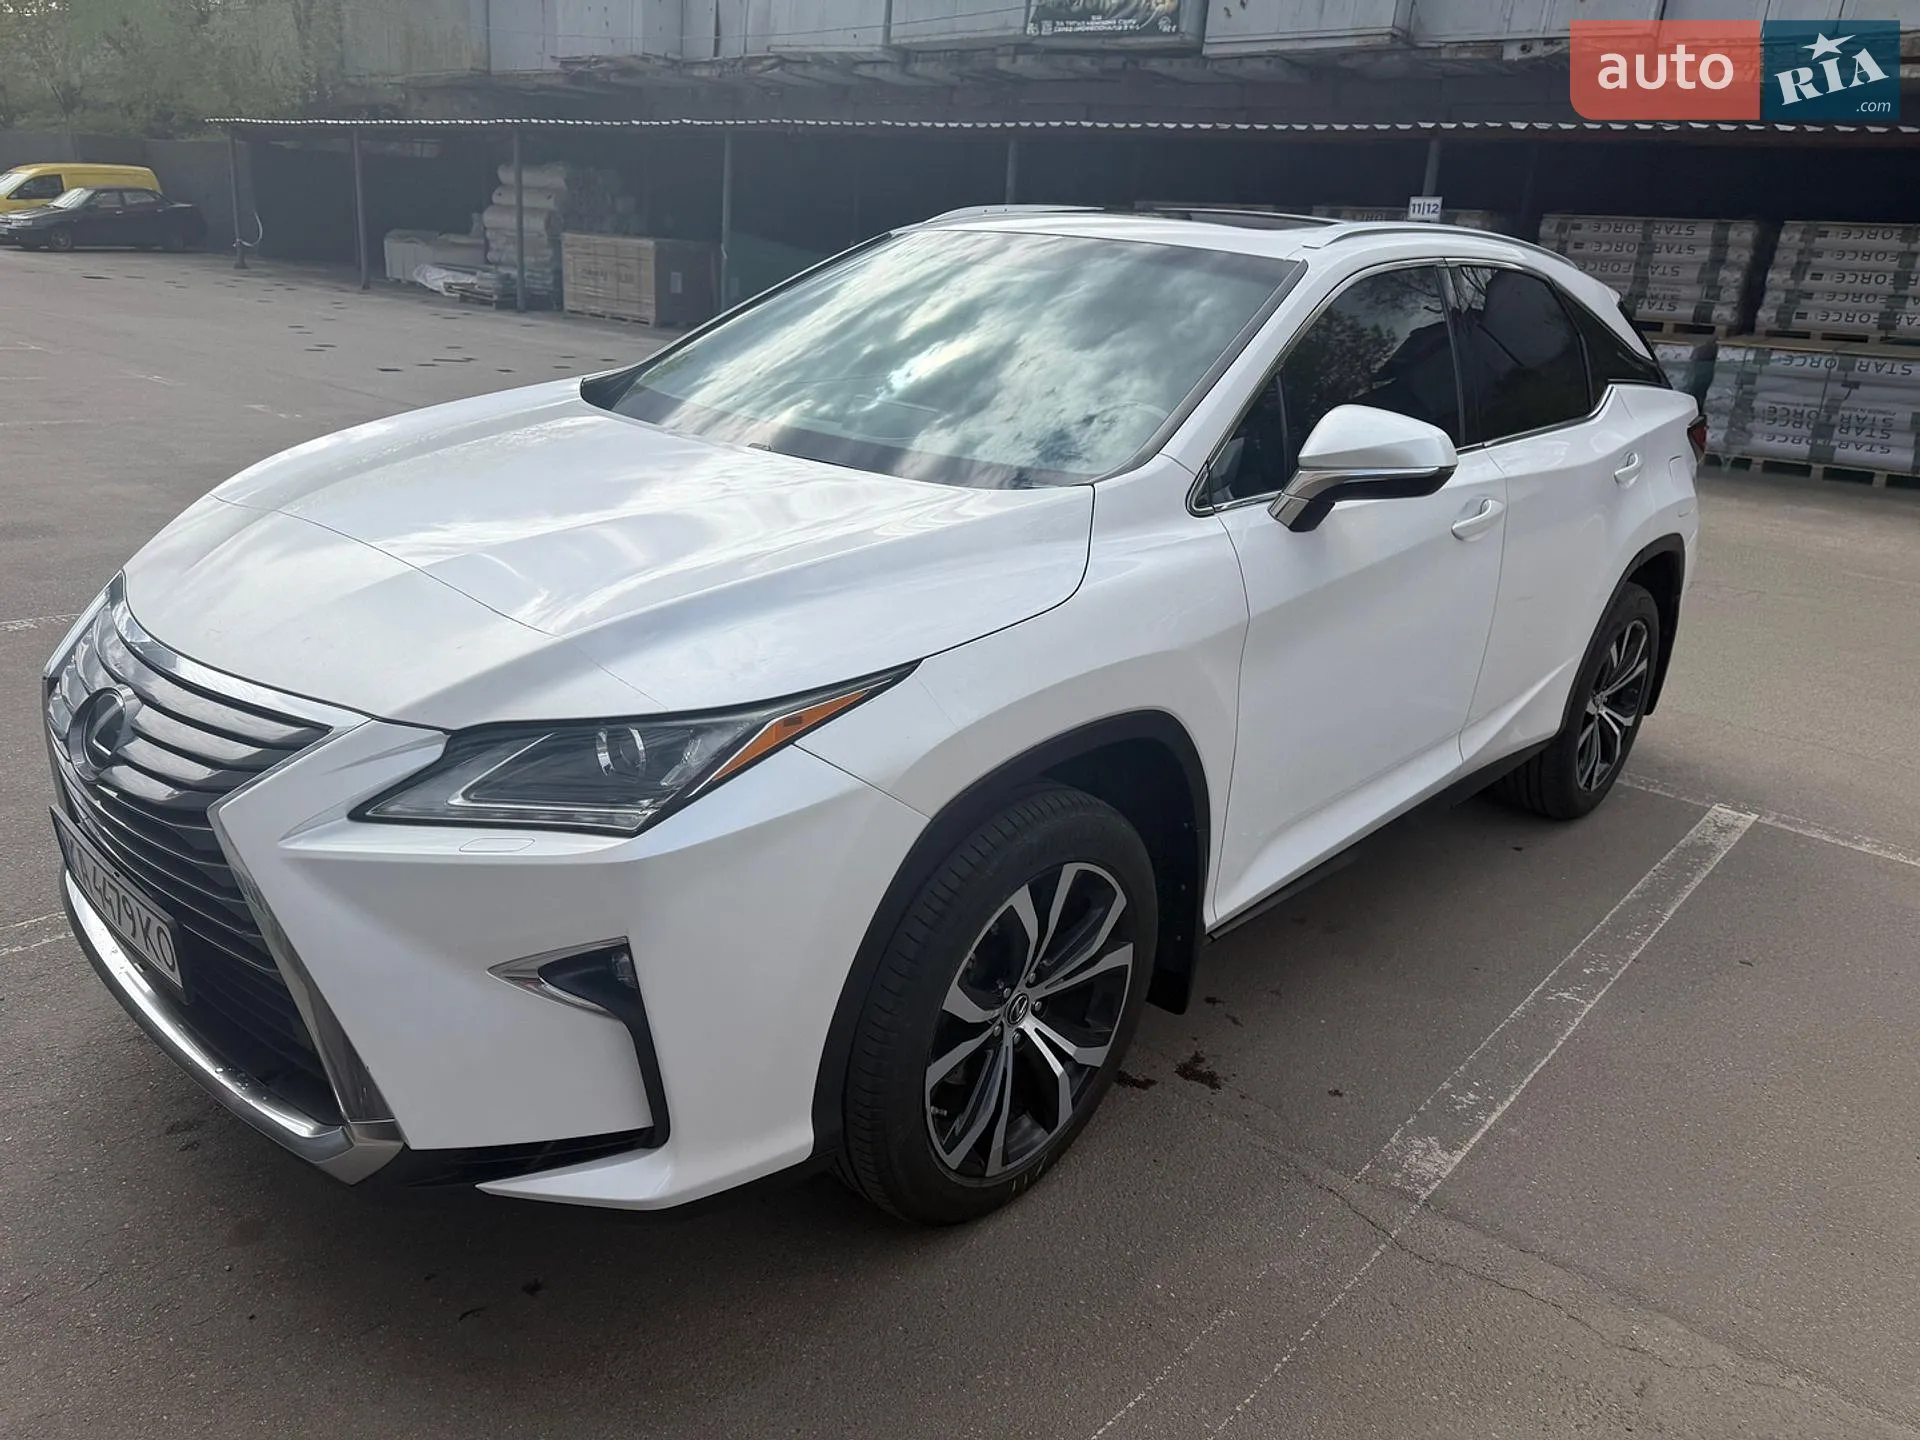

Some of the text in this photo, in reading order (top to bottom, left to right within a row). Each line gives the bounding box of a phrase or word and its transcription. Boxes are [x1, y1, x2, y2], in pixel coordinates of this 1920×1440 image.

[1594, 240, 1637, 253] ORCE
[1836, 250, 1900, 263] FORCE
[1648, 264, 1681, 277] STA
[1782, 354, 1914, 376] STAR ORCE
[1765, 416, 1815, 431] ORCE
